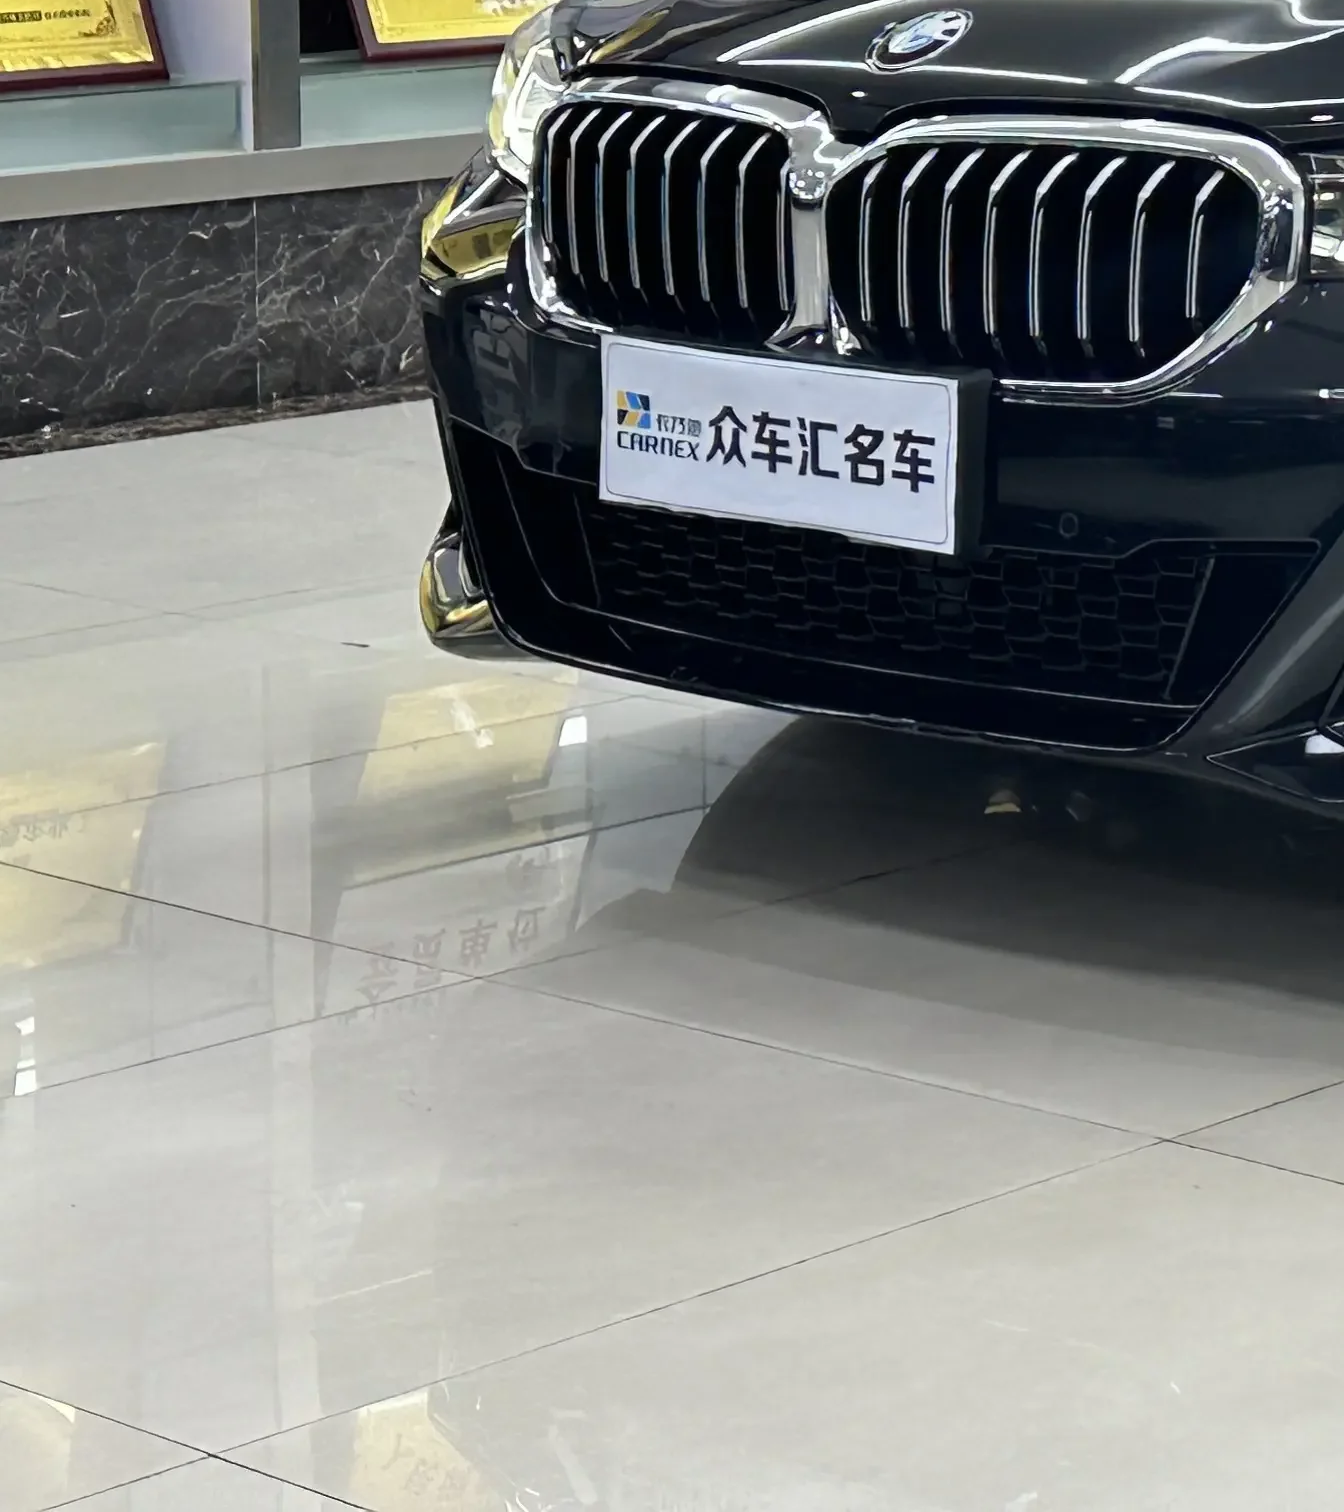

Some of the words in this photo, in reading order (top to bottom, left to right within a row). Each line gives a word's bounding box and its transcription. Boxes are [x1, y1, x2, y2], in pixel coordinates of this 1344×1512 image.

[616, 429, 701, 463] CARNEX
[704, 404, 937, 494] 众车汇名车
